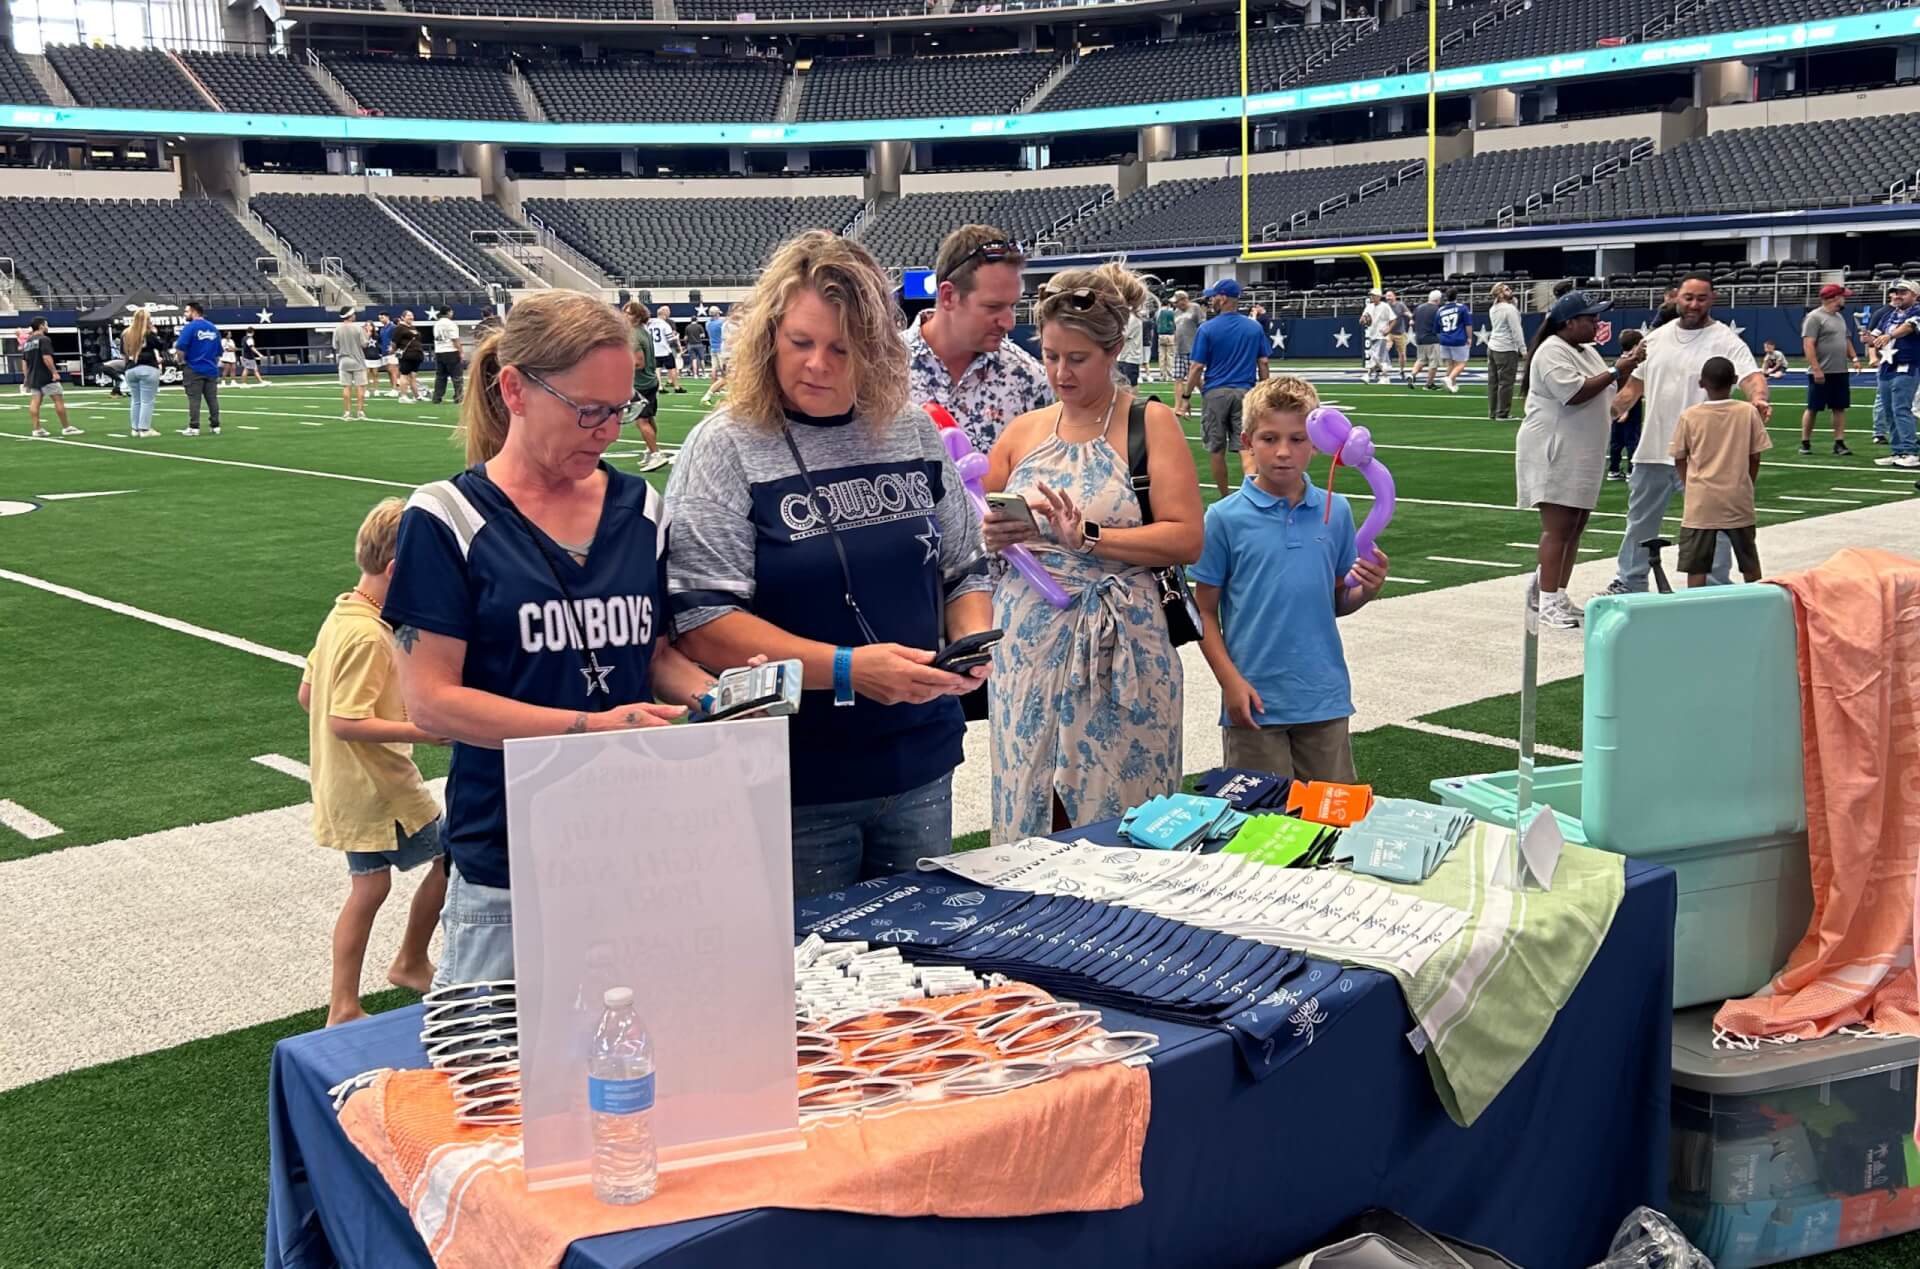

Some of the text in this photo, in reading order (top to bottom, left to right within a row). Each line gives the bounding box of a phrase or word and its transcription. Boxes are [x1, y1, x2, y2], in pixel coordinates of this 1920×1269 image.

[1441, 313, 1459, 332] 97
[779, 471, 935, 531] COWBOYS
[518, 595, 653, 653] COWBOYS
